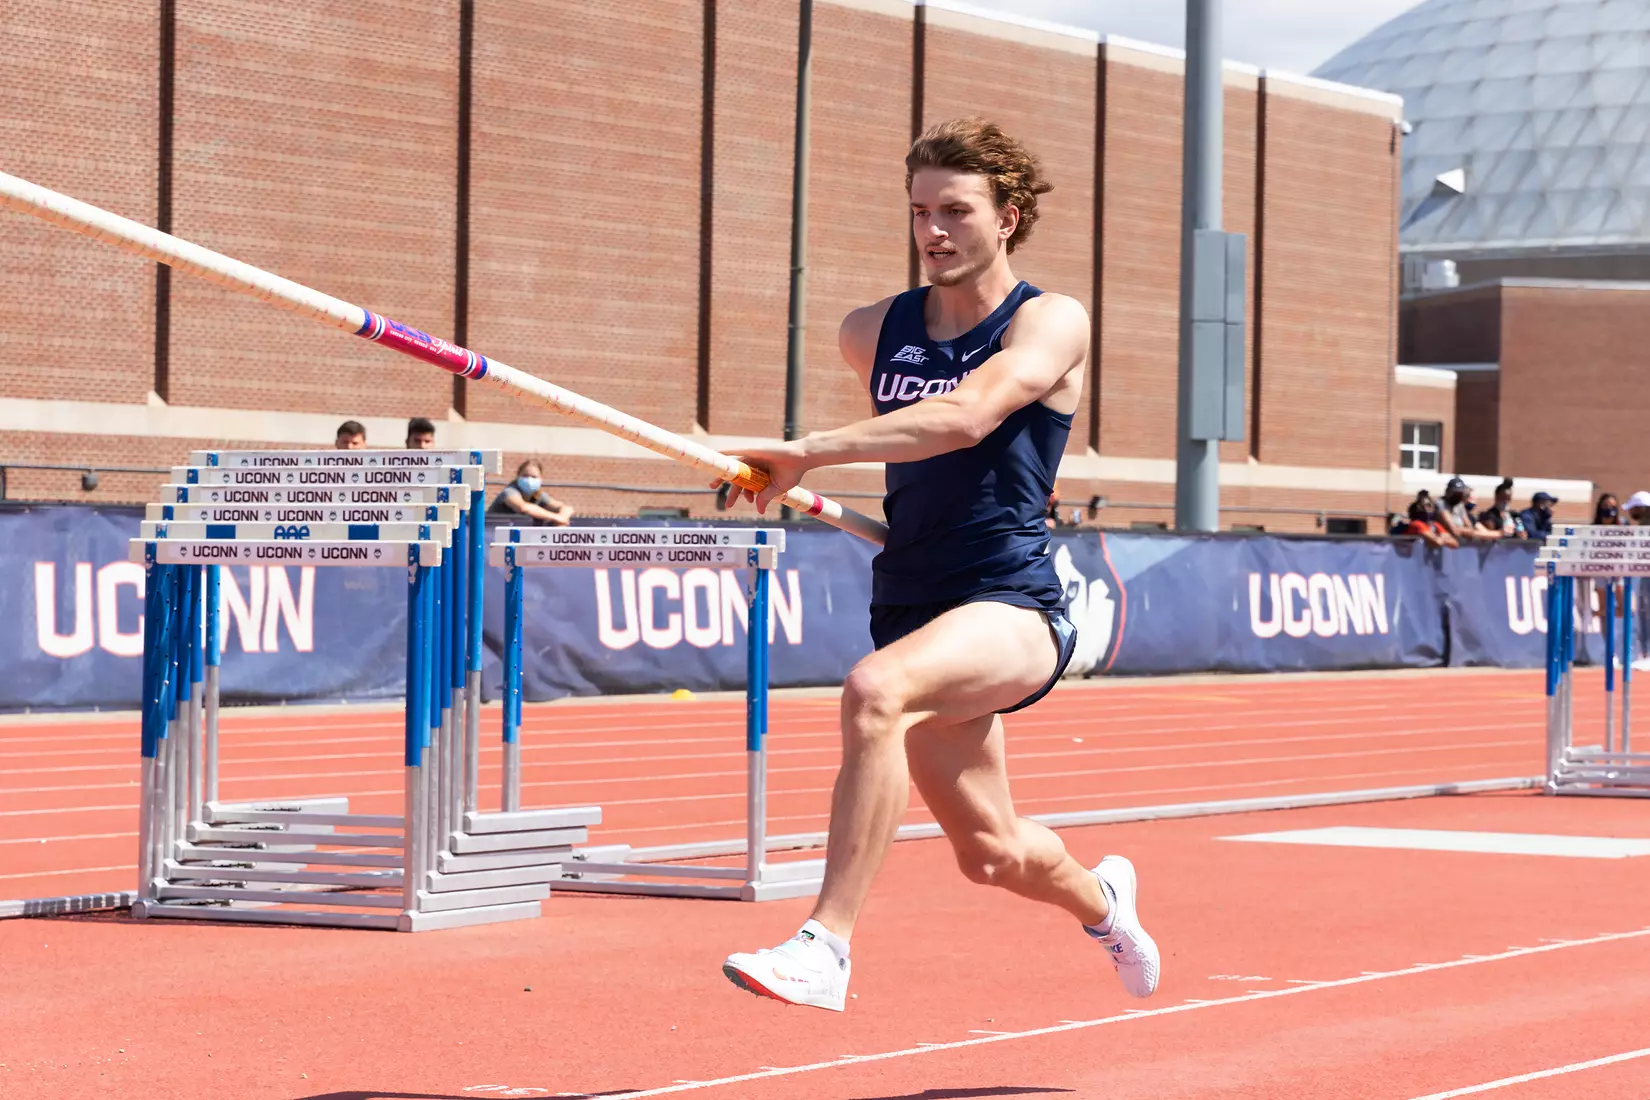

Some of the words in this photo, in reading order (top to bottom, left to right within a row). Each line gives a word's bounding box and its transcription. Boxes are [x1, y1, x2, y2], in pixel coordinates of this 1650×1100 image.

[900, 344, 926, 354] BIG
[893, 351, 930, 363] EAST
[877, 369, 978, 402] UCON
[235, 471, 281, 484] UCONN
[299, 471, 346, 484] UCONN
[364, 470, 412, 484] UCONN
[224, 490, 269, 503] UCONN
[287, 490, 333, 503] UCONN
[351, 490, 398, 503] UCONN
[213, 509, 259, 522] UCONN
[277, 509, 324, 522] UCONN
[342, 509, 389, 522] UCONN
[552, 532, 595, 545] UCONN
[612, 532, 656, 545] UCONN
[673, 533, 717, 545] UCONN
[192, 545, 238, 559] UCONN
[256, 546, 303, 559] UCONN
[321, 546, 368, 560] UCONN
[549, 549, 592, 562] UCONN
[608, 549, 651, 562] UCONN
[667, 549, 712, 562] UCONN
[34, 560, 316, 657] UCNN
[594, 566, 803, 650] UCONN
[1248, 571, 1389, 638] UCONN
